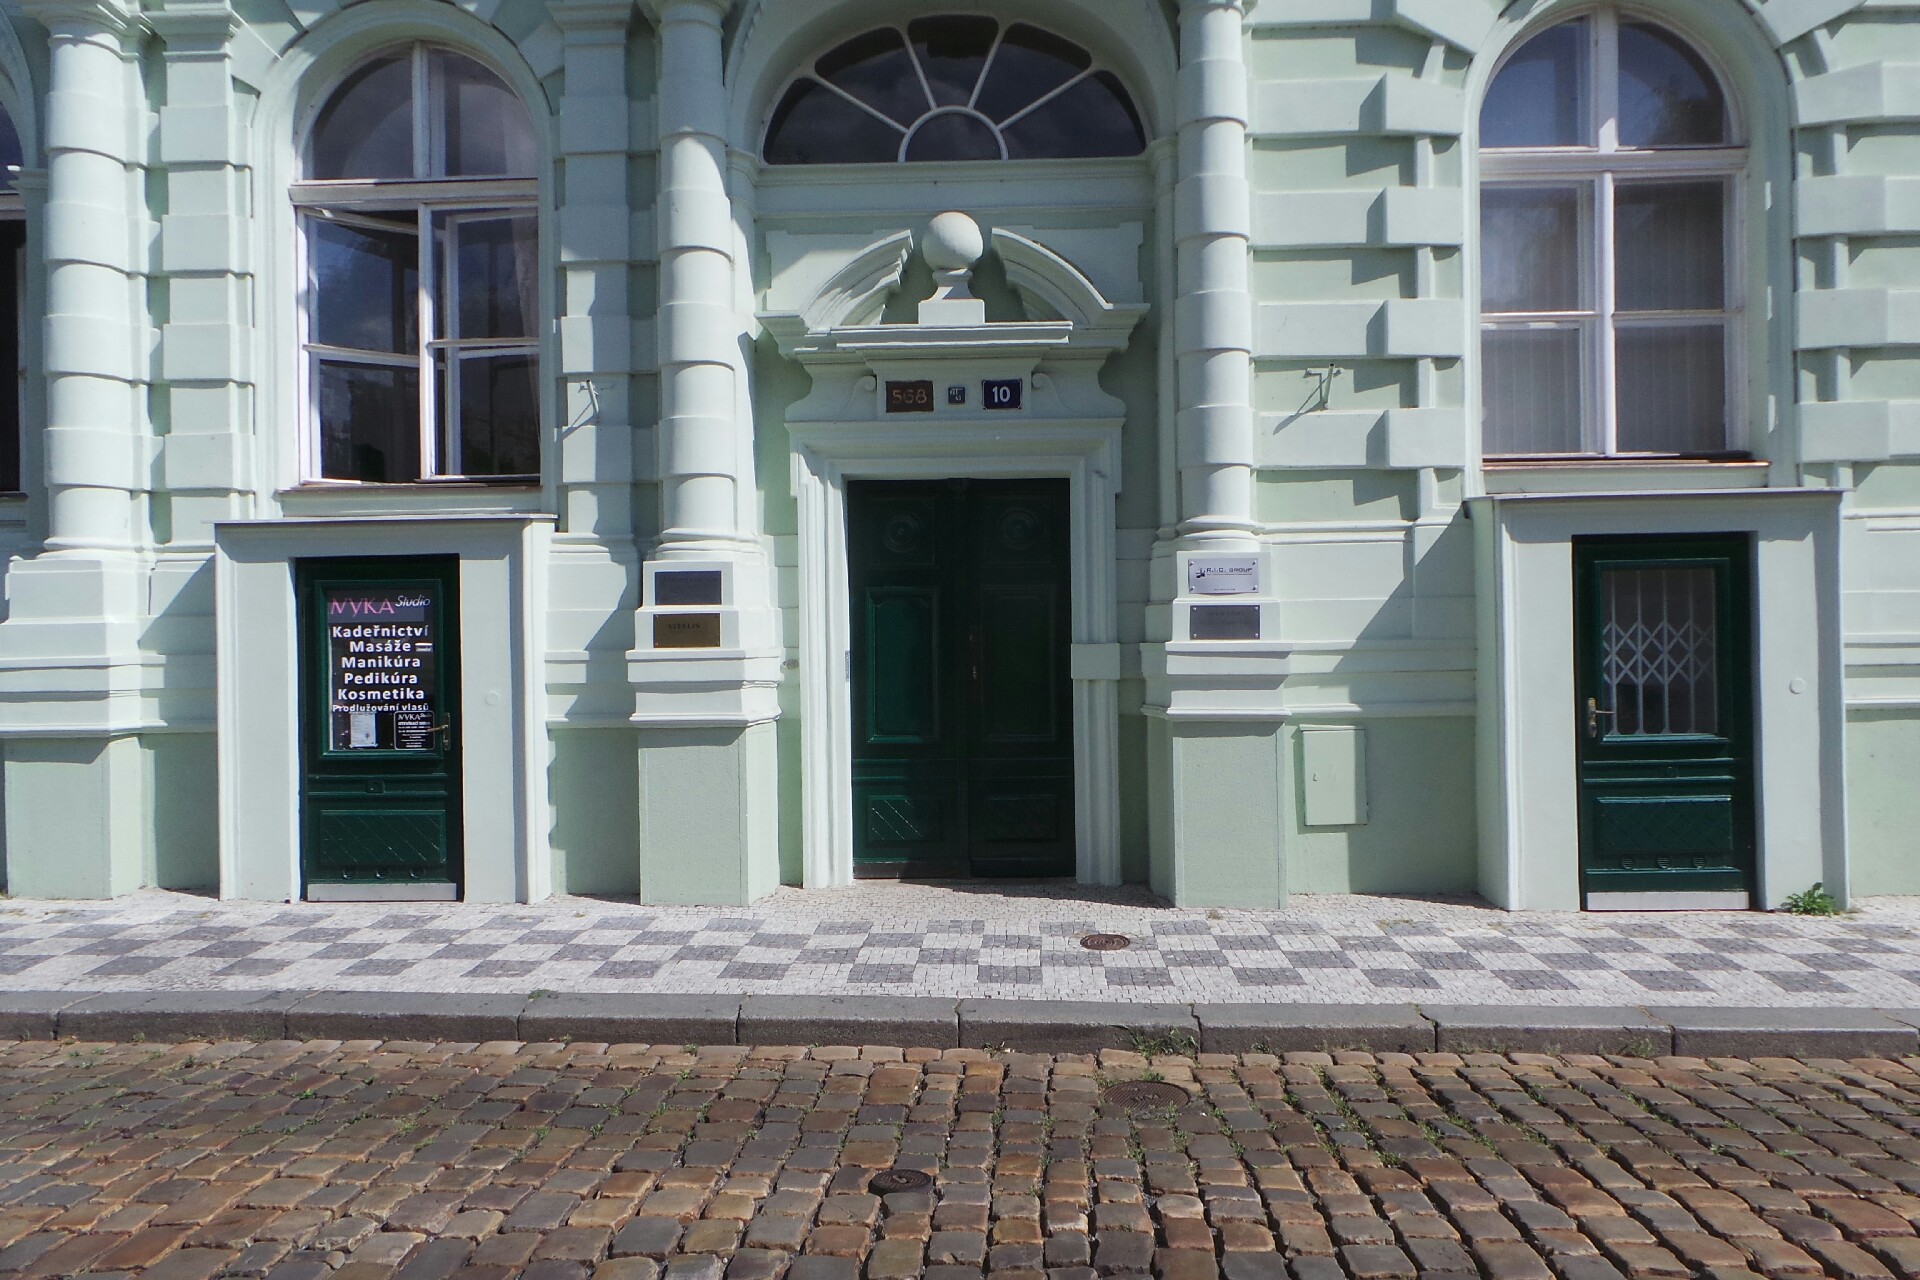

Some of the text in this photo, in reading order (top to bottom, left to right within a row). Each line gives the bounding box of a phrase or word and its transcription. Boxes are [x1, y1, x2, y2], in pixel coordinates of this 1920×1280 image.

[892, 389, 927, 404] 568
[992, 386, 1011, 403] 10
[330, 594, 431, 617] NYKA Studio
[332, 625, 429, 639] Kadeřnictví
[350, 641, 411, 653] Masáže
[342, 655, 421, 668] Manikúra
[344, 672, 418, 684] Pedikúra
[338, 688, 425, 700] Kosmetika
[332, 703, 429, 713] Prodlužování vlasů
